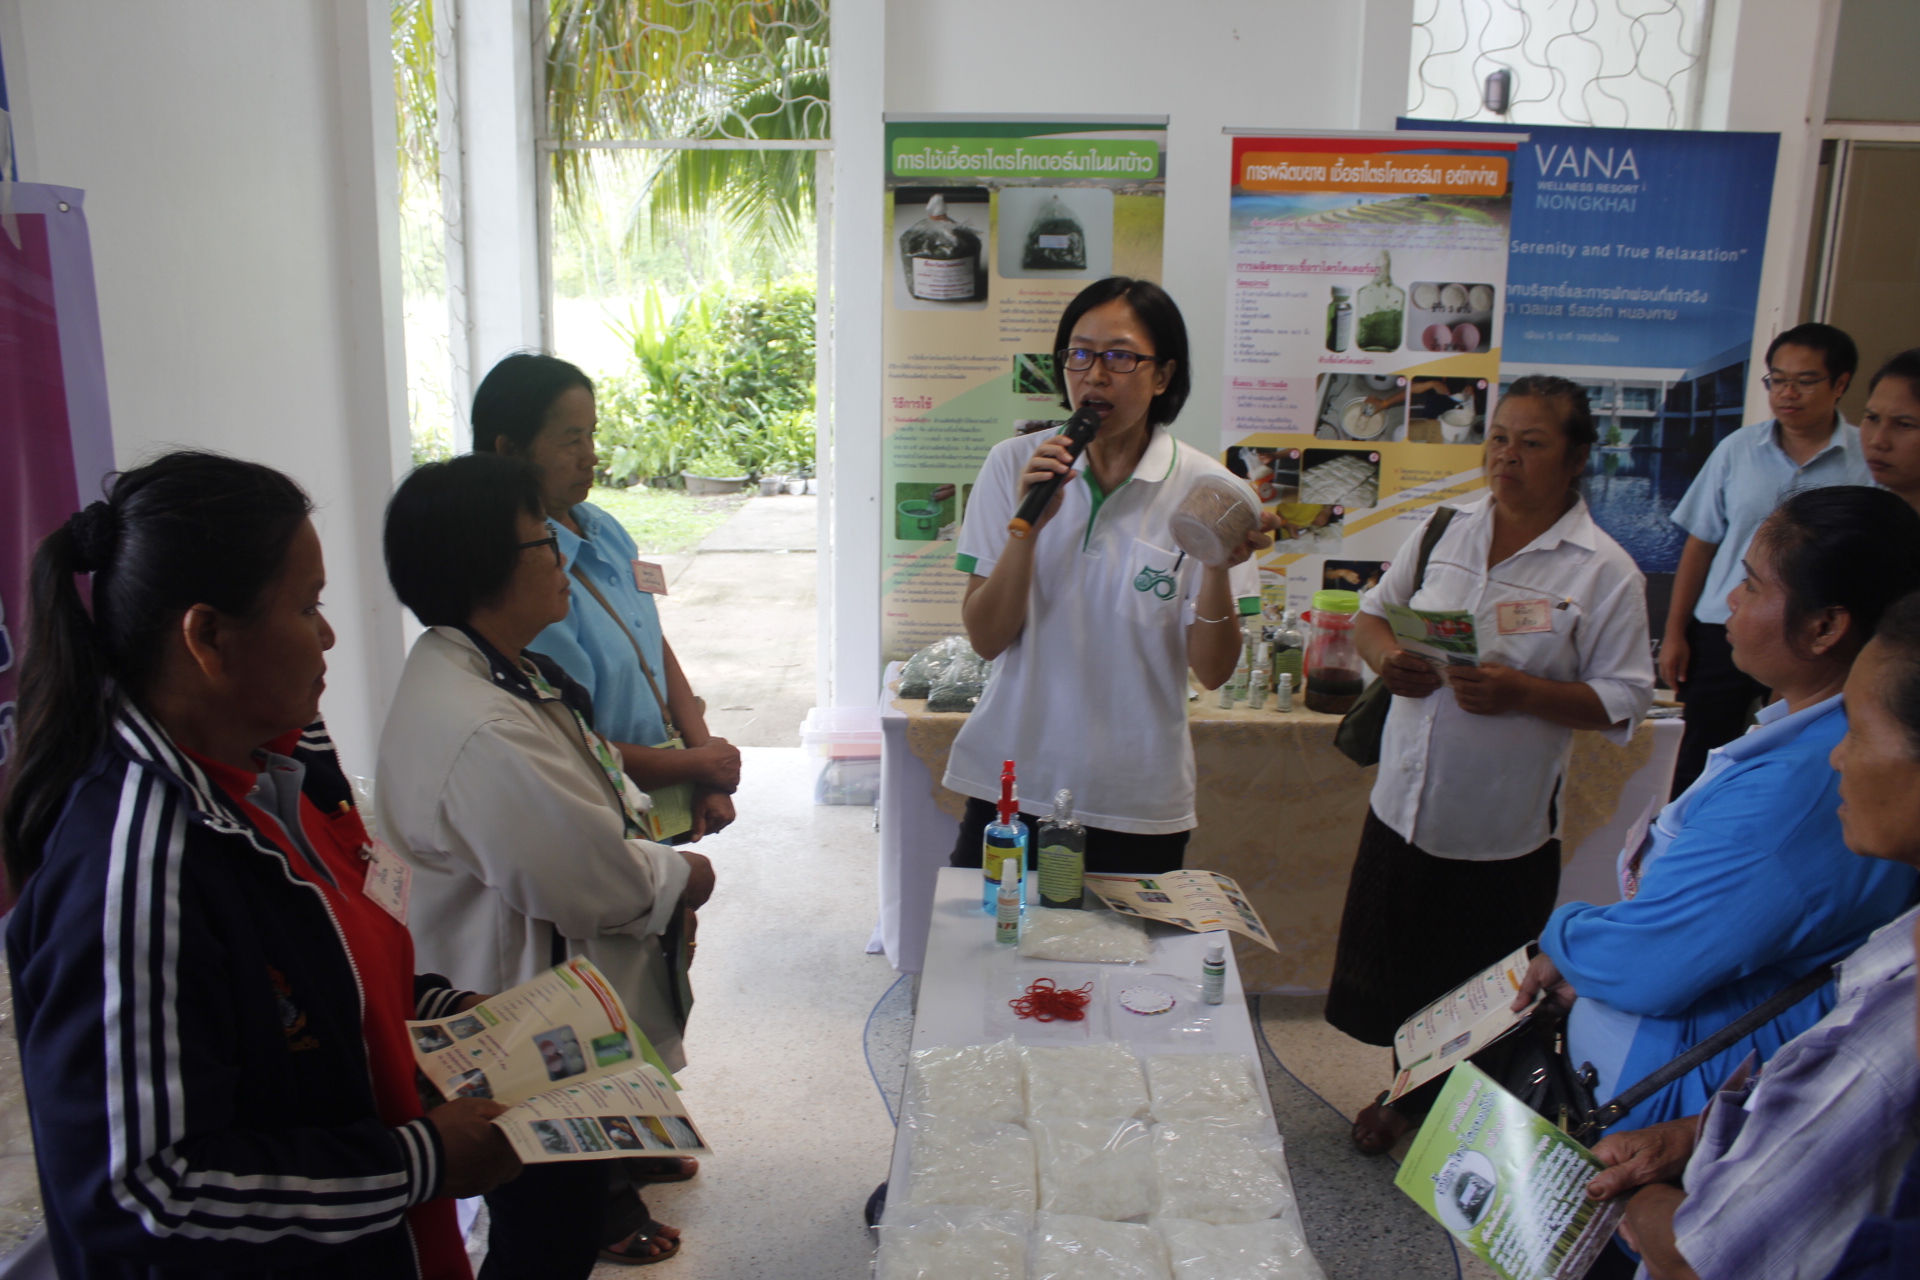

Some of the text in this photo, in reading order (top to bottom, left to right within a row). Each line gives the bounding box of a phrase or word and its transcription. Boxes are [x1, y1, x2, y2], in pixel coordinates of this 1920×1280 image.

[1534, 144, 1639, 180] VANA
[1537, 181, 1639, 194] WELLNESS RESORT
[1535, 194, 1637, 212] NONGKHAI
[1511, 240, 1576, 259] Serenity
[1581, 243, 1611, 257] and
[1616, 244, 1650, 259] True
